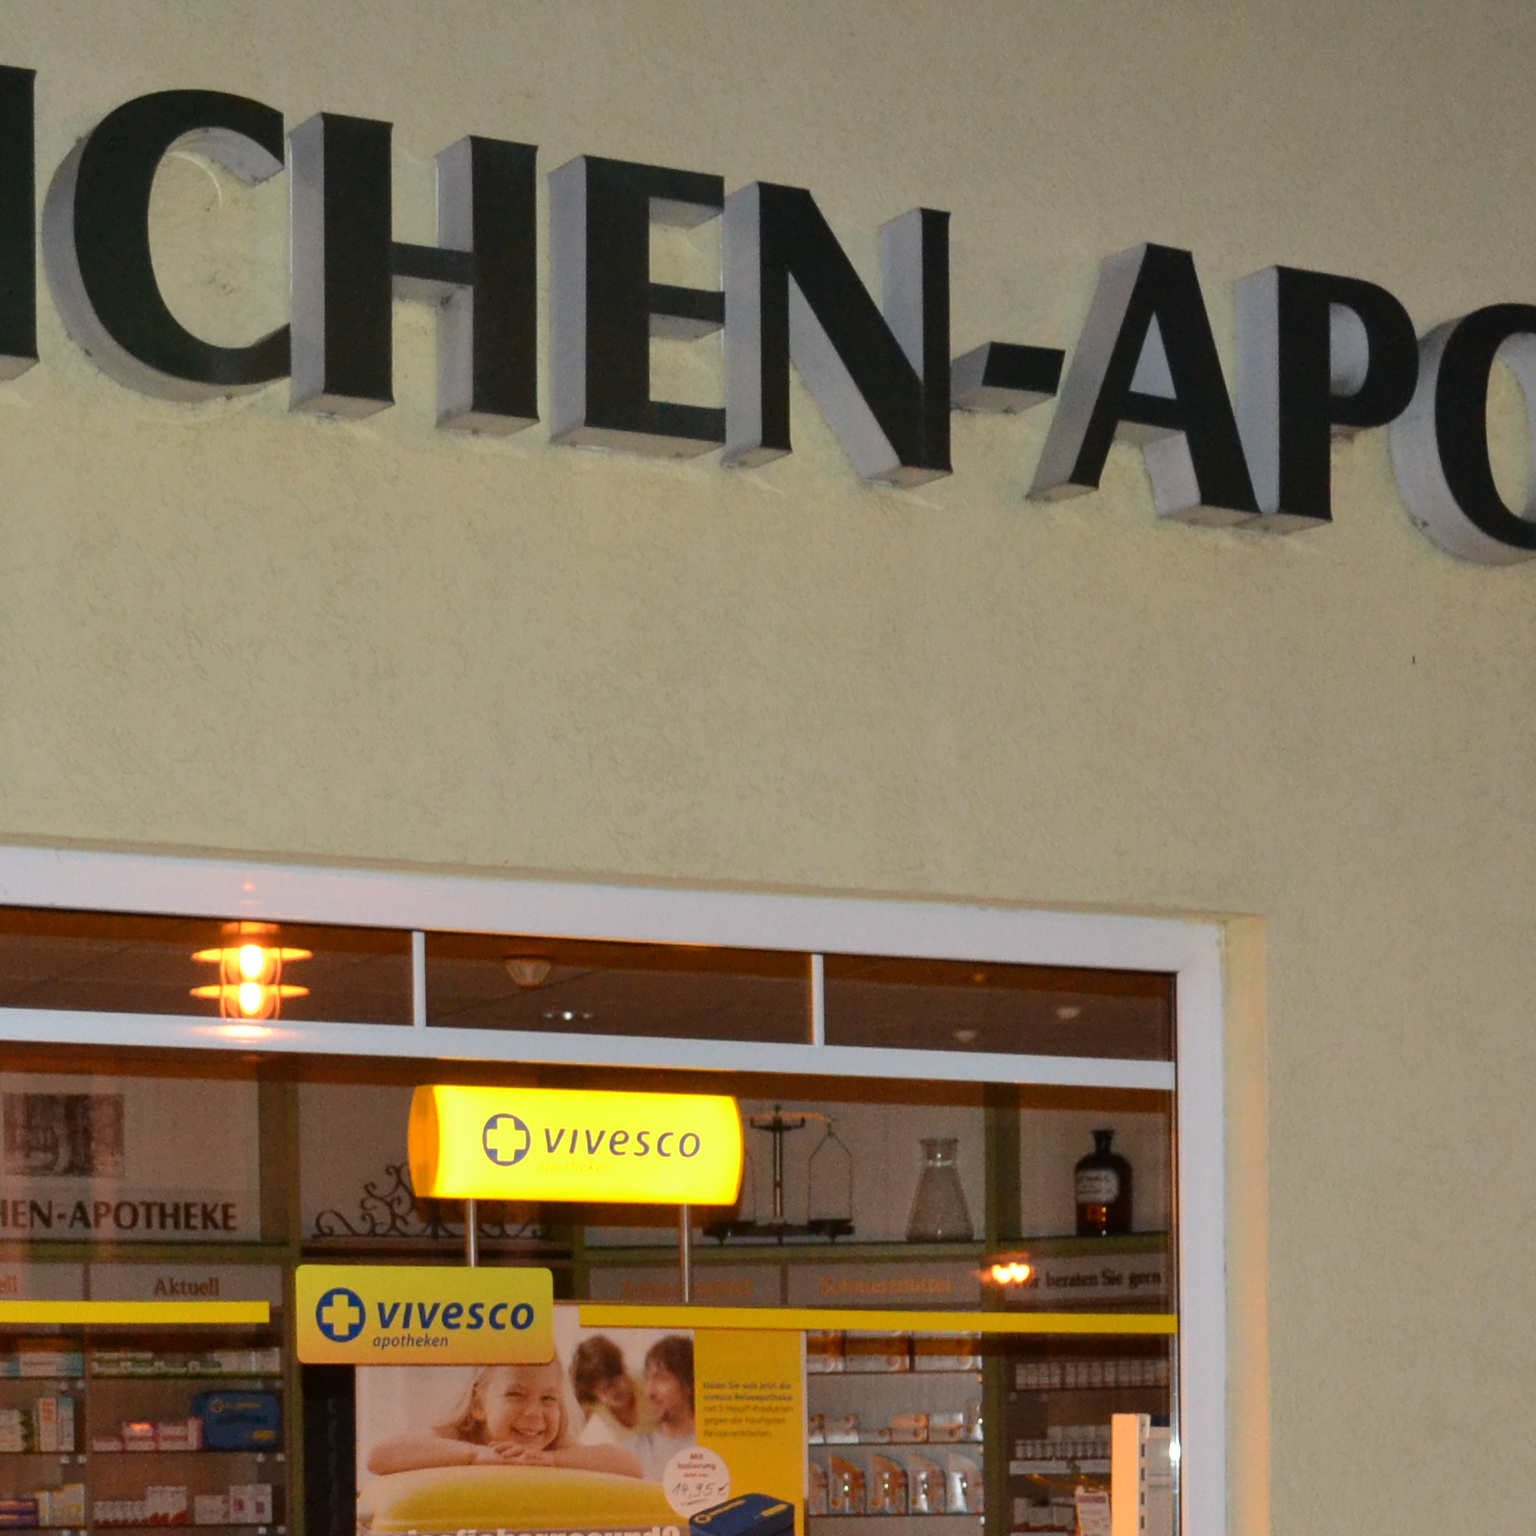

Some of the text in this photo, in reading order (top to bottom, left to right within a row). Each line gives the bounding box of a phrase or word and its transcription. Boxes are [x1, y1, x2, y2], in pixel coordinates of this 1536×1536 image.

[544, 1128, 701, 1158] vivesco
[536, 1161, 613, 1174] apotheken
[154, 1277, 220, 1297] Aktuell
[1046, 1272, 1099, 1288] beraten
[1102, 1268, 1124, 1286] Sie
[1128, 1270, 1161, 1290] gern
[377, 1302, 534, 1331] vivesco
[373, 1333, 448, 1349] apotheken
